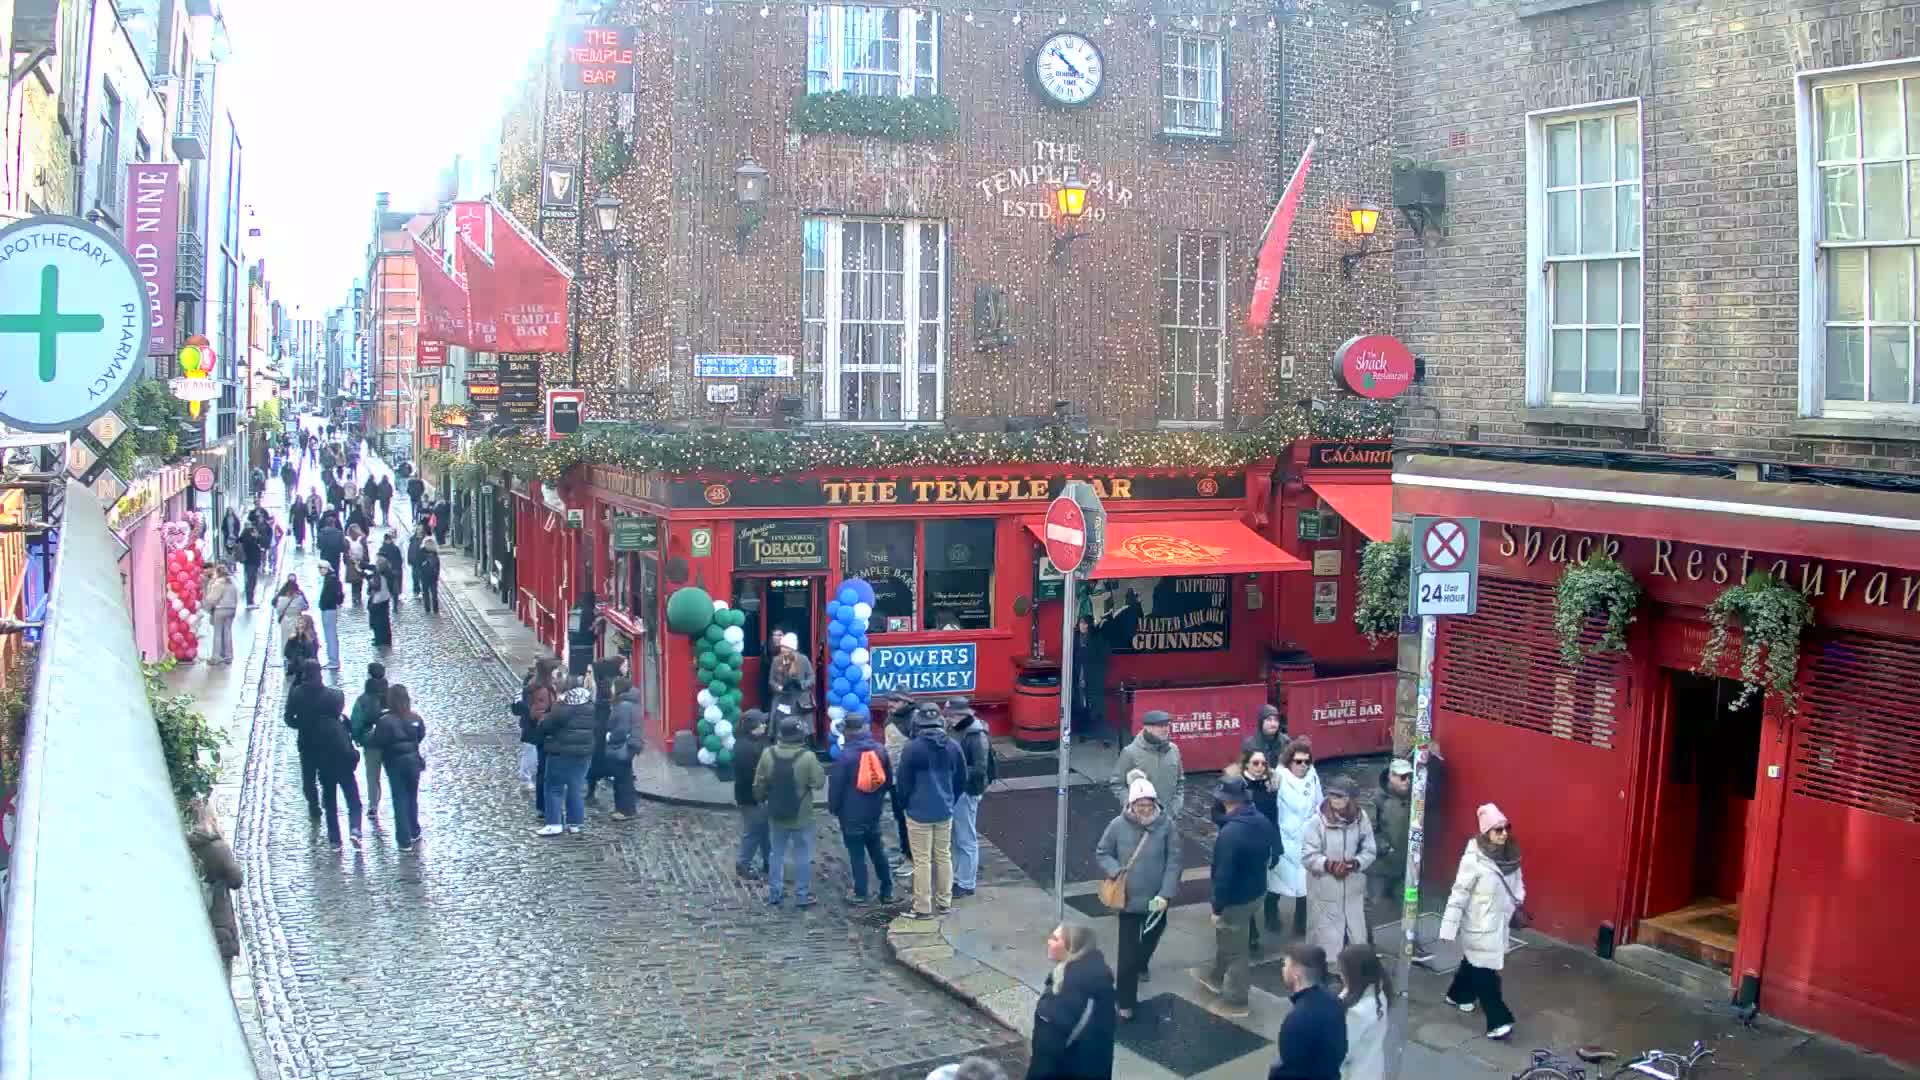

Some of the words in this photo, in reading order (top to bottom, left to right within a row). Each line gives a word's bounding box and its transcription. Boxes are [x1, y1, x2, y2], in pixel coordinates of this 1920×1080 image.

[584, 30, 617, 45] THE
[568, 48, 633, 65] TEMPLE
[583, 70, 617, 84] BAR
[1033, 140, 1081, 162] THE
[136, 171, 169, 232] NINE
[541, 209, 577, 218] GUINNESS
[502, 312, 561, 326] TEMPLE
[516, 325, 549, 337] BAR
[87, 302, 137, 400] PHARMACY
[510, 363, 529, 371] BAR
[1355, 350, 1388, 373] Shack
[1372, 371, 1409, 381] Restaurant
[823, 480, 898, 504] THE
[911, 478, 1049, 502] TEMPLE
[1092, 478, 1134, 499] AR
[749, 538, 817, 562] TOBACCO
[1500, 522, 1620, 567] Shack
[852, 565, 890, 580] EMPLE
[1175, 578, 1226, 593] EMPEROR
[1421, 583, 1442, 603] 24
[1443, 593, 1465, 602] HOUR
[1136, 616, 1181, 633] MALTED
[1131, 631, 1224, 650] GUINNESS
[880, 648, 969, 668] POWER'S
[873, 670, 974, 692] WHISKEY
[1312, 706, 1357, 721] TEMPLE
[1359, 703, 1384, 715] BAR
[1339, 700, 1357, 708] THE
[1191, 711, 1213, 721] THE
[1215, 717, 1241, 729] BAR
